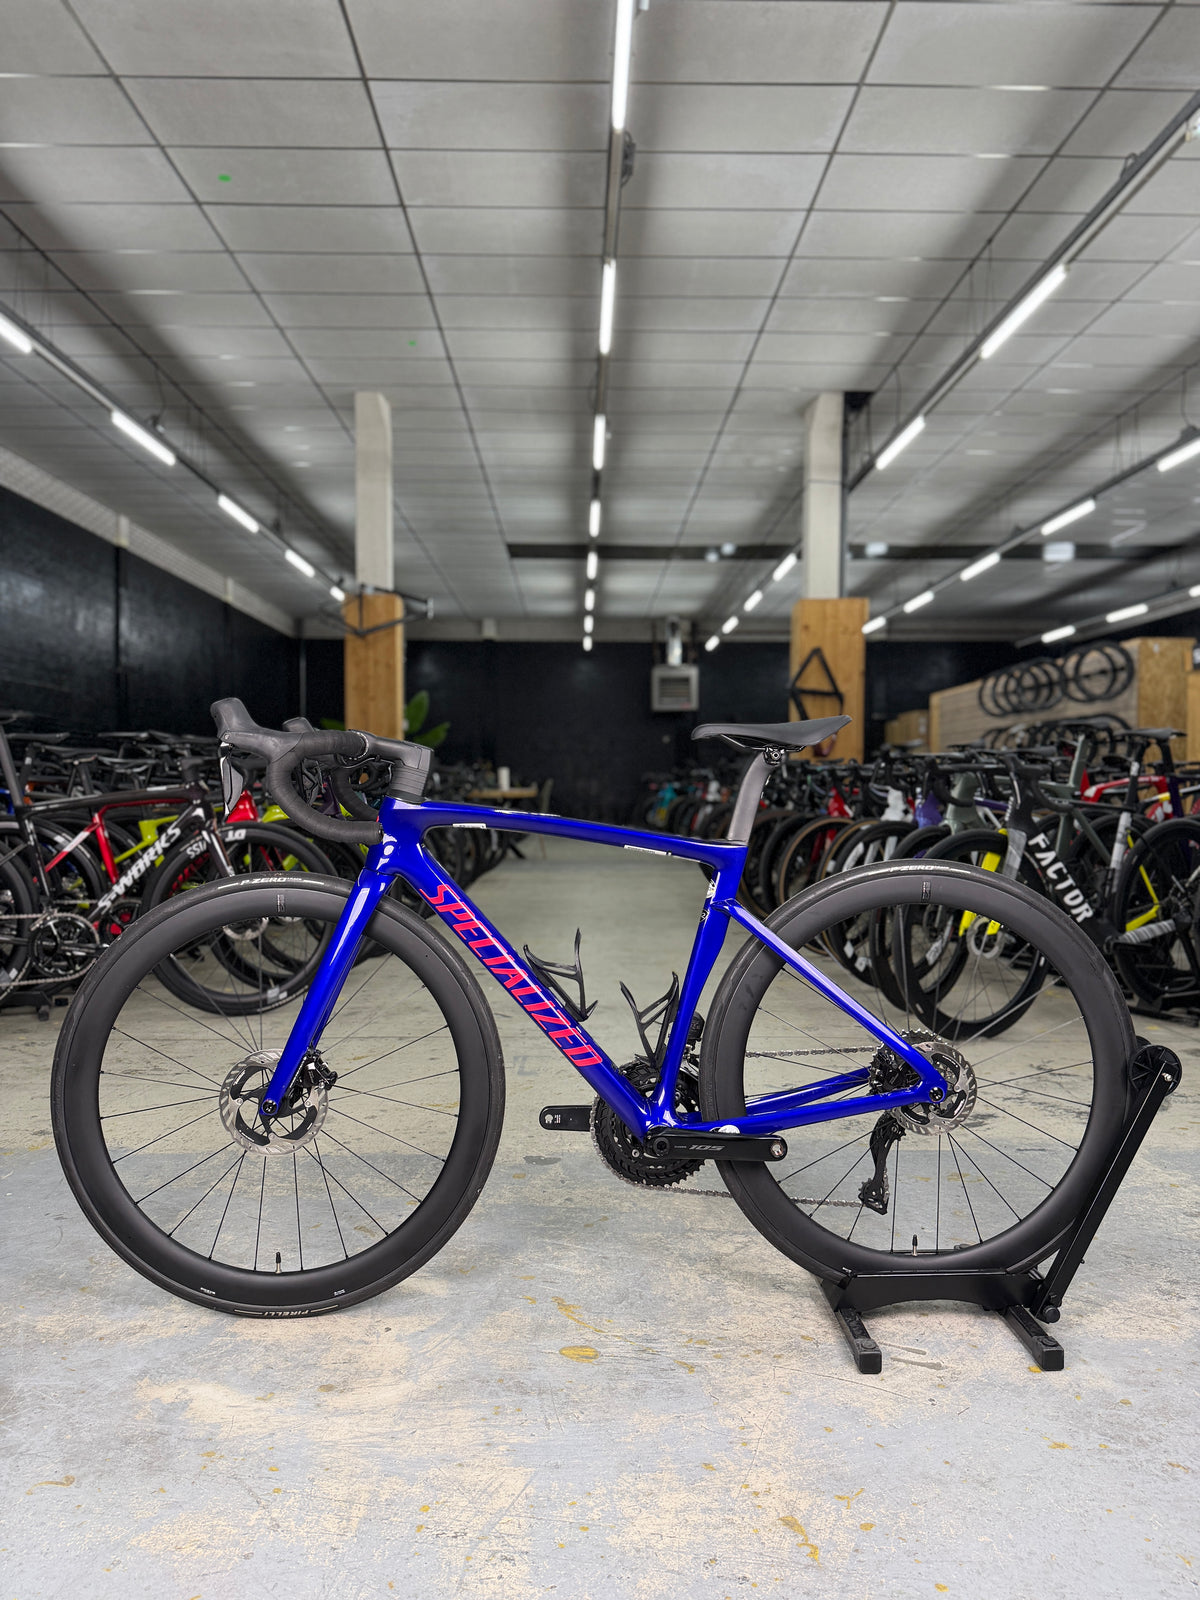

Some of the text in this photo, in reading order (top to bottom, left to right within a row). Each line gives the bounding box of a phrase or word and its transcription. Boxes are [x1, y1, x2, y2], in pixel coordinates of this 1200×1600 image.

[97, 825, 182, 916] S-WORKS
[225, 829, 247, 842] DT
[1028, 832, 1094, 923] FACTOR
[419, 884, 603, 1067] SPECIALIZED
[264, 1309, 309, 1317] PIRELLI
